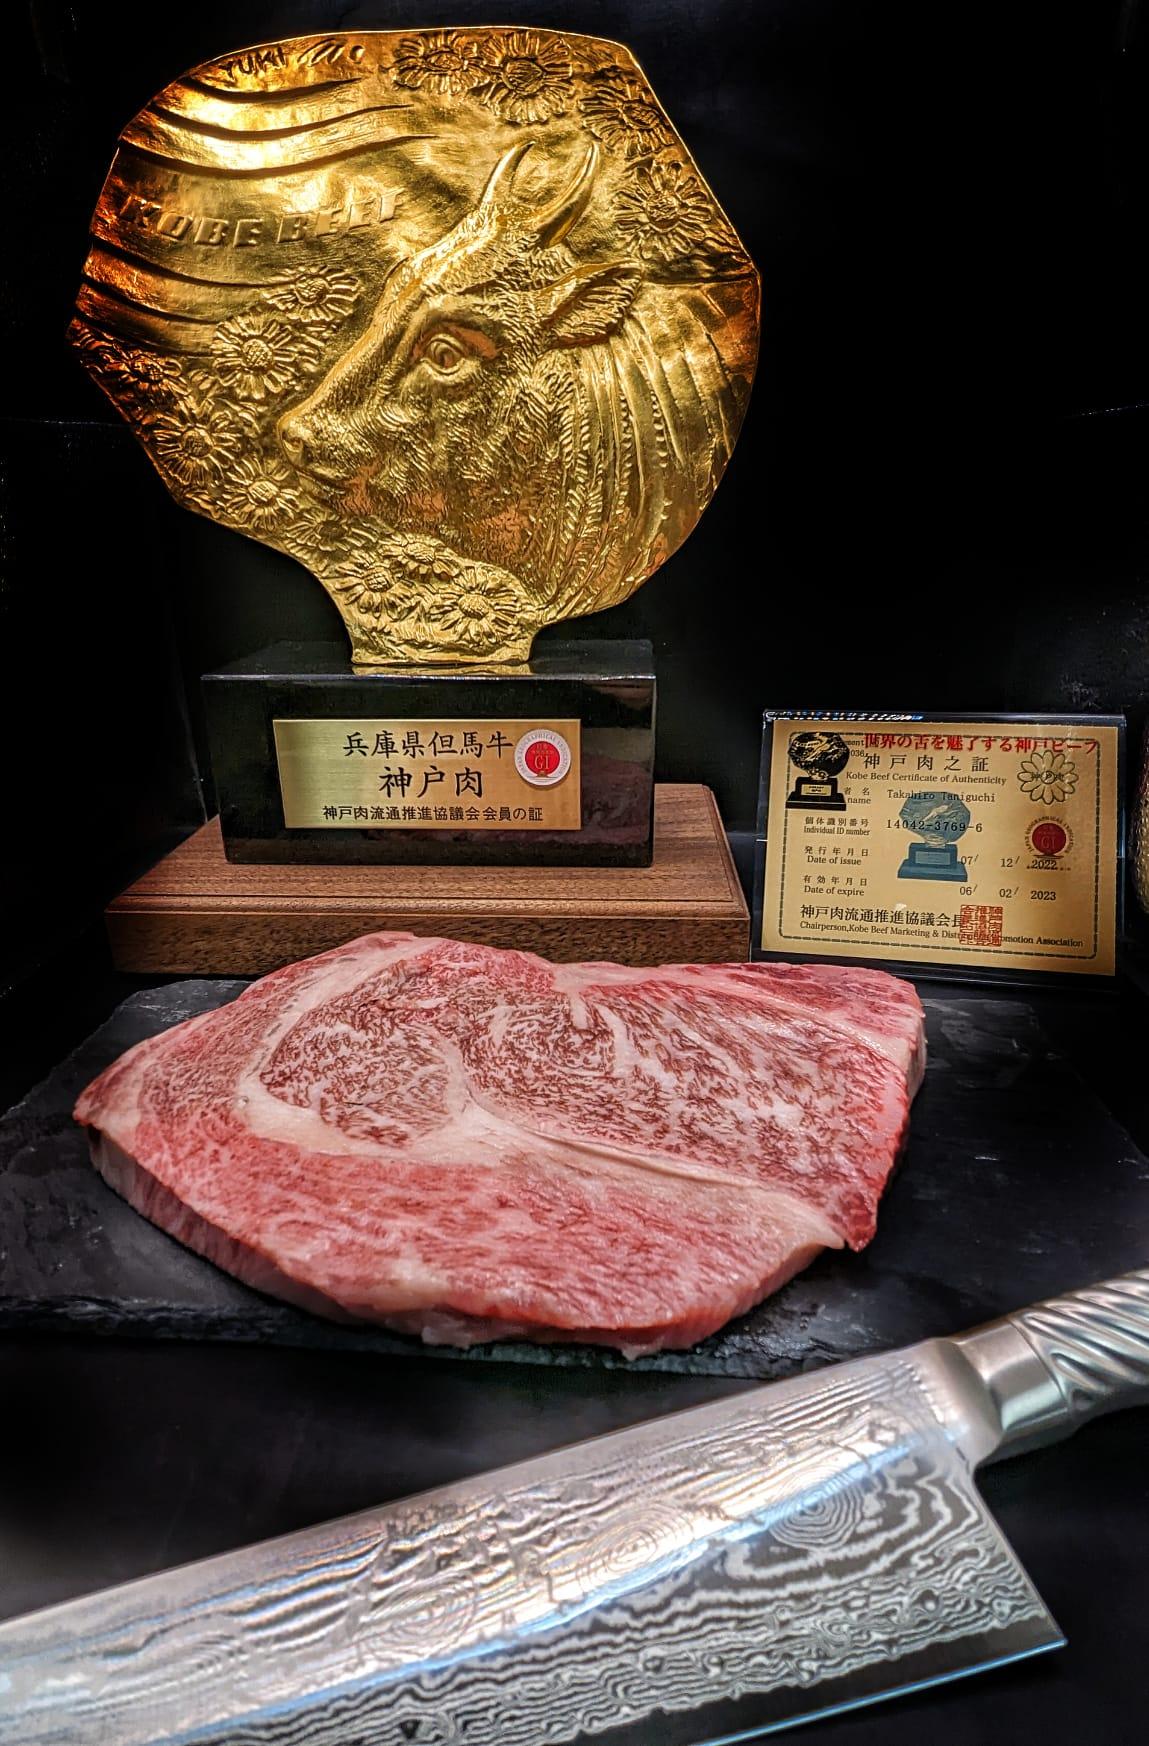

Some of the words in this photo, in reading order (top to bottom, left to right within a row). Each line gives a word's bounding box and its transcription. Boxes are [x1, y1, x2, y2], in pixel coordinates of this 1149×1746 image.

[119, 194, 266, 248] KOBE
[276, 187, 406, 244] BEEF
[343, 731, 514, 759] 兵庫県但馬牛
[378, 765, 484, 799] 神戸肉
[846, 772, 868, 780] Kobe
[871, 772, 889, 781] Beef
[892, 773, 938, 783] Certificate
[940, 774, 949, 782] of
[952, 775, 1006, 786] Authenticity
[887, 790, 935, 800] Takahiro
[322, 805, 544, 823] 神戸肉流通推進協議会会員の証
[807, 855, 827, 864] Date
[840, 857, 862, 866] issue
[804, 885, 824, 895] Date
[826, 886, 835, 894] of
[837, 888, 865, 897] expire
[1030, 890, 1057, 901] 2023
[870, 925, 889, 935] Beef
[890, 927, 931, 939] Marketing
[1036, 937, 1084, 948] Association
